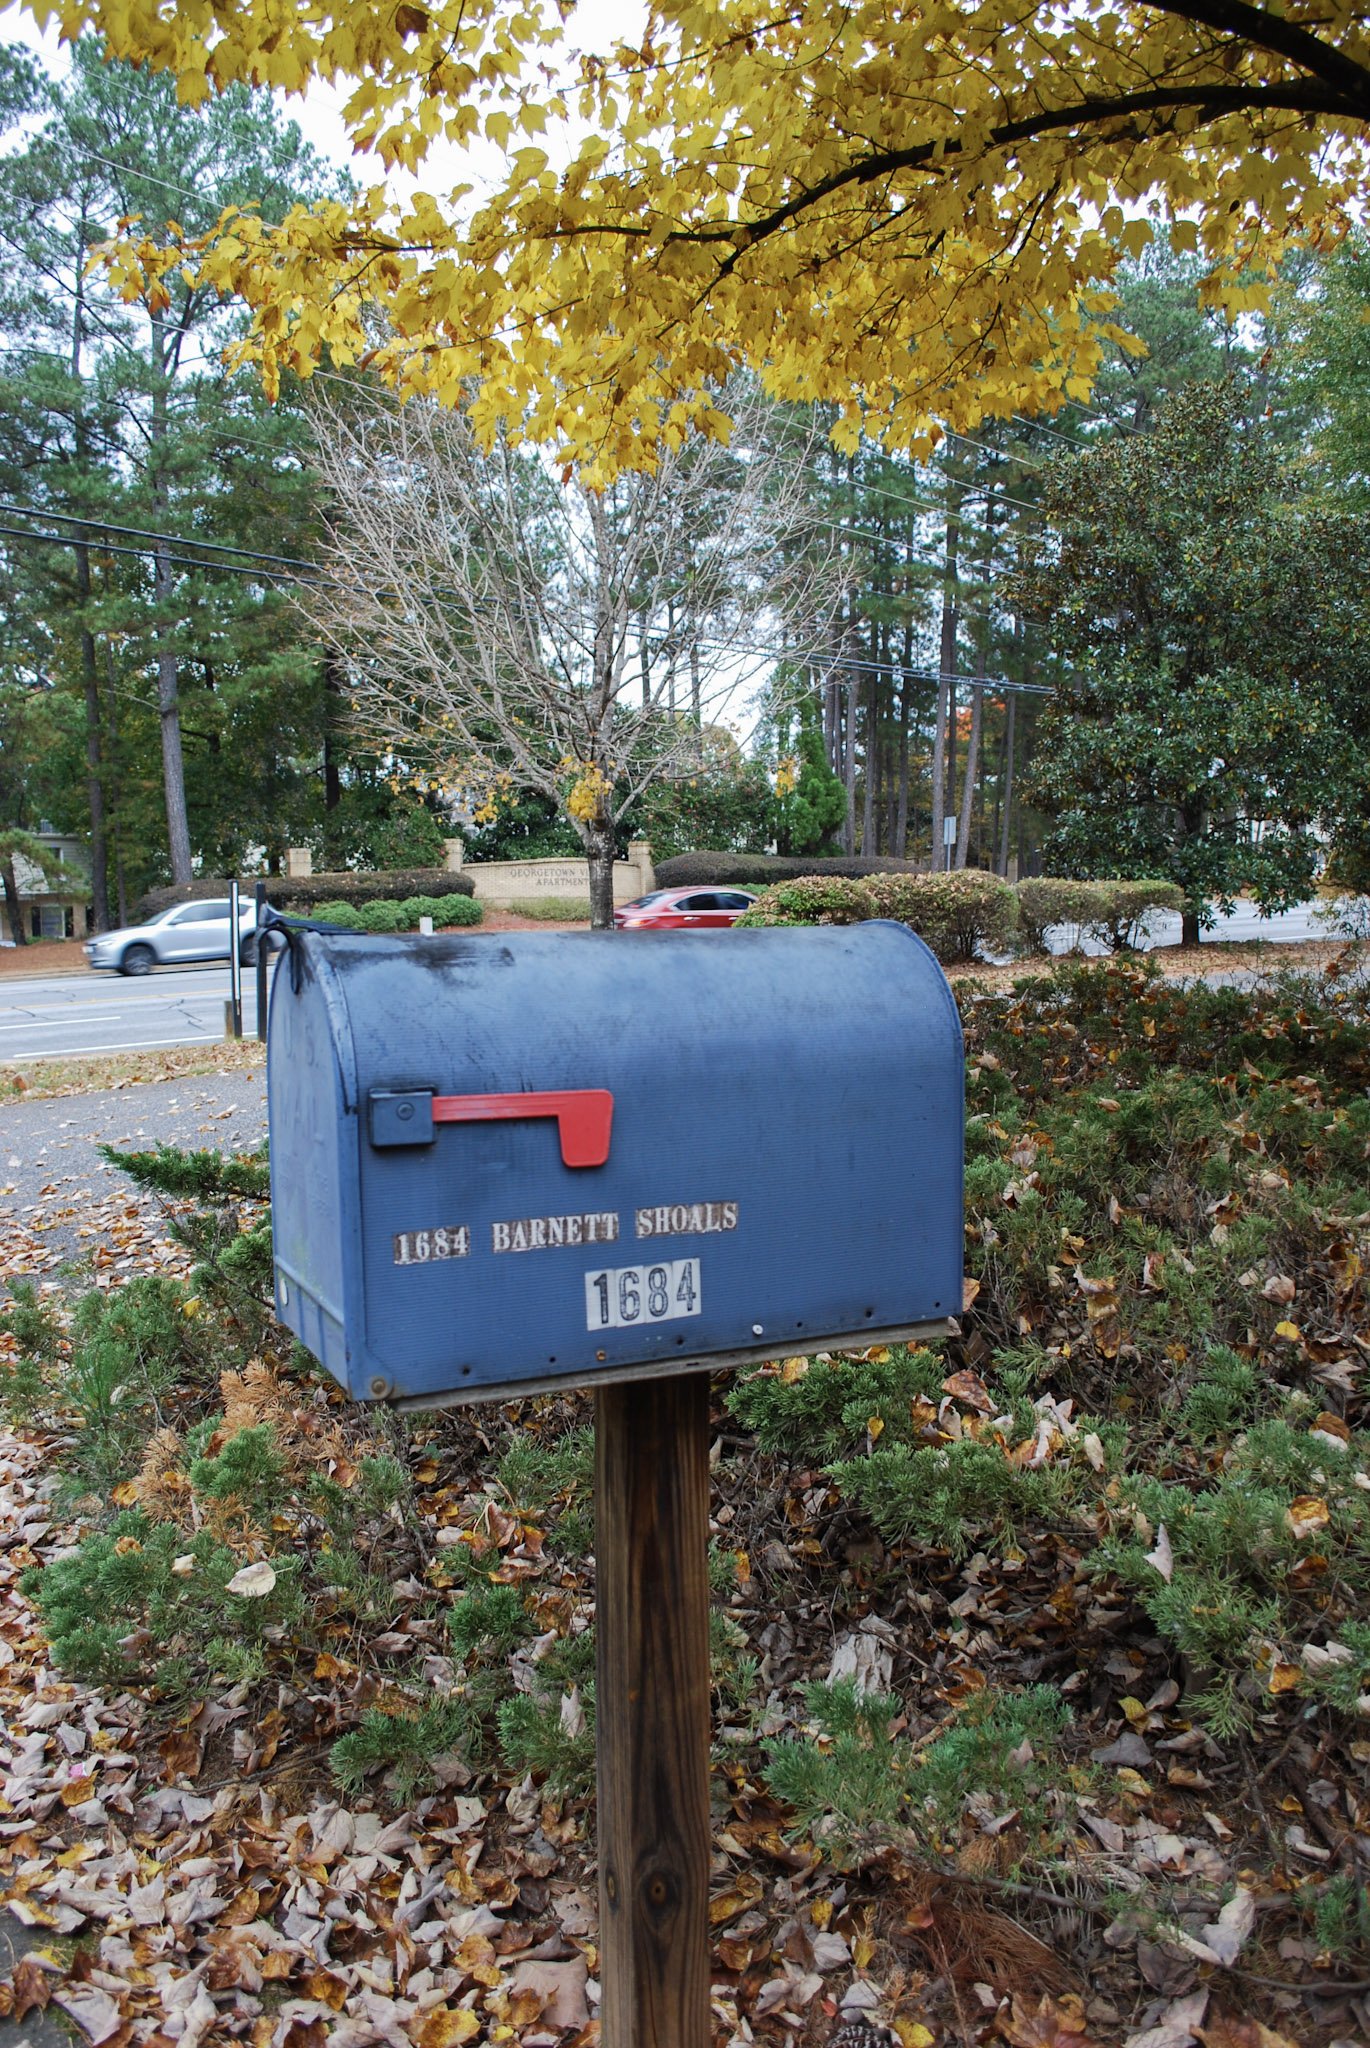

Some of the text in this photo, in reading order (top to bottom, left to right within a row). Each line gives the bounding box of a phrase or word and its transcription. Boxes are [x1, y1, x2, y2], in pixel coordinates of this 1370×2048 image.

[536, 878, 589, 886] APARTMENT
[396, 1202, 738, 1264] 1684 BARNETT SHOALS
[592, 1262, 696, 1324] 1684
